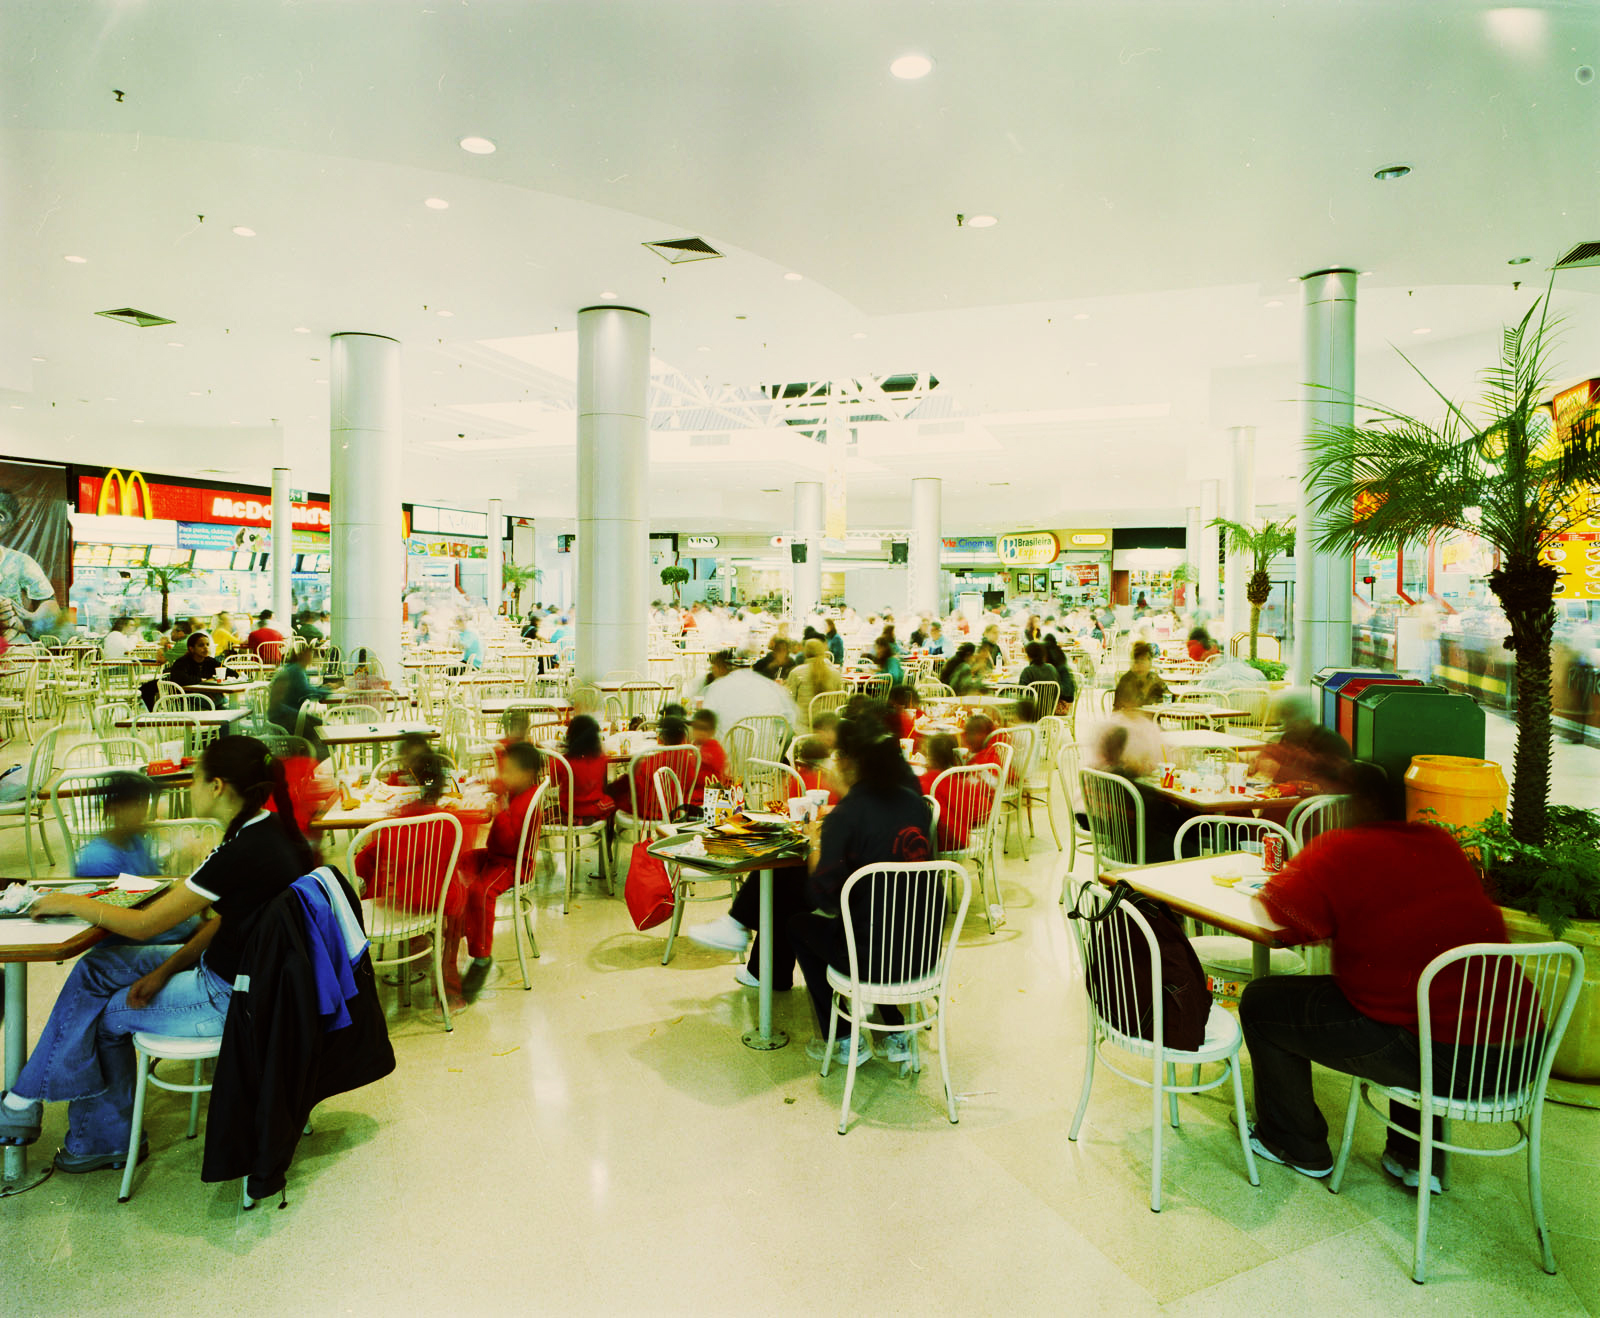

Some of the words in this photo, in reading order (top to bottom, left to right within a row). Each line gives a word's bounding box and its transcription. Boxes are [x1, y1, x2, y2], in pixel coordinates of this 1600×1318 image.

[212, 497, 331, 525] McDoald's
[959, 538, 994, 548] Cinemas
[1017, 538, 1052, 547] Brasileira
